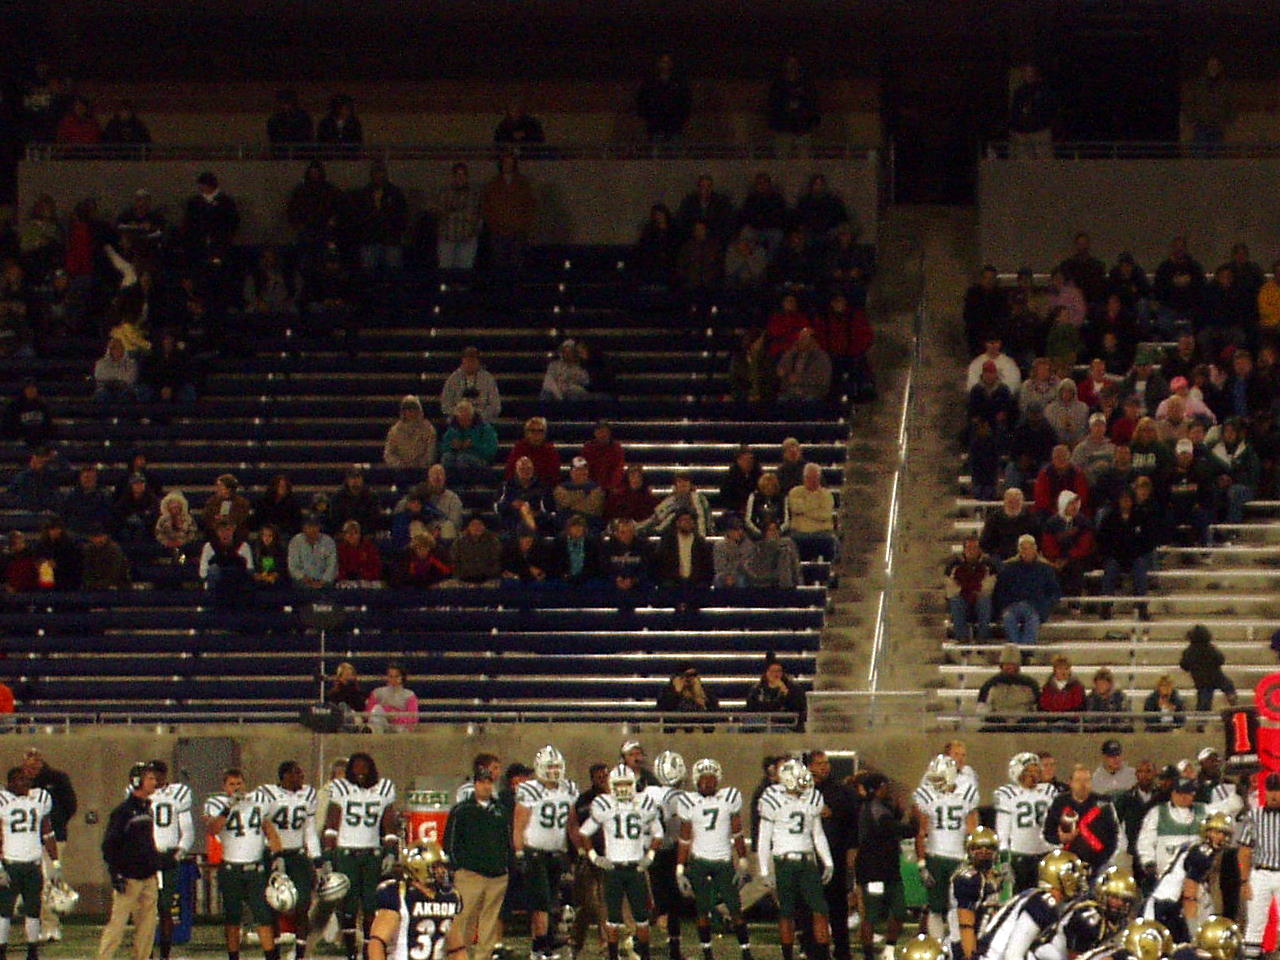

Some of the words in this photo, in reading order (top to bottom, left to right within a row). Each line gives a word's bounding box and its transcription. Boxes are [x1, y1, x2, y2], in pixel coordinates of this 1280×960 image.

[1232, 711, 1252, 753] 1
[9, 807, 38, 834] 21
[225, 806, 263, 838] 44
[344, 800, 381, 828] 55
[539, 801, 570, 829] 92
[613, 812, 641, 840] 16
[702, 808, 718, 831] 7
[788, 811, 805, 834] 3
[935, 805, 963, 831] 15
[417, 820, 438, 844] G
[412, 901, 456, 917] AKRON
